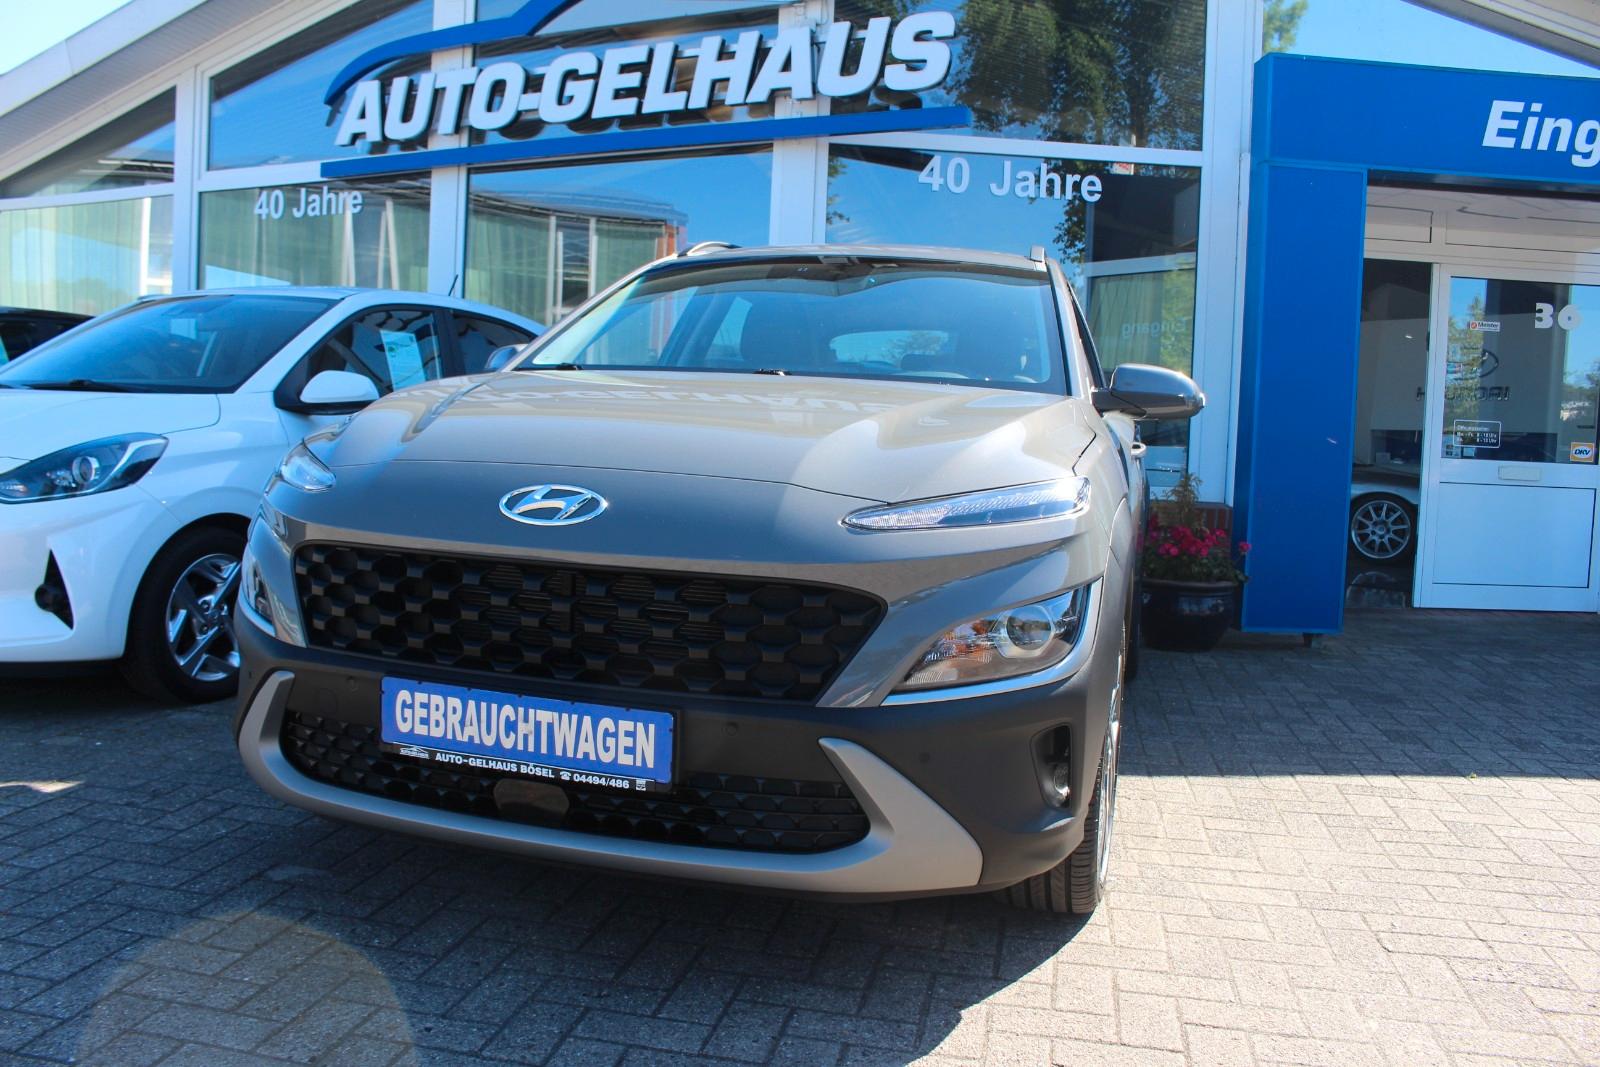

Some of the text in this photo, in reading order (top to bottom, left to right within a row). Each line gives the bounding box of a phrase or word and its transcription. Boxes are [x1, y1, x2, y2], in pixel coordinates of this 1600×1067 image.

[334, 12, 956, 147] AUTO-GELHAUS
[1482, 99, 1600, 168] Eing
[254, 185, 364, 220] 40 Jahre
[918, 155, 1103, 203] 40 Jahre
[1534, 302, 1584, 330] 36
[395, 689, 655, 768] GEBRAUCHTWAGEN
[435, 753, 517, 772] AUTO-GELHAUS
[520, 763, 555, 778] BÖSEL
[573, 773, 630, 789] 04494/486
